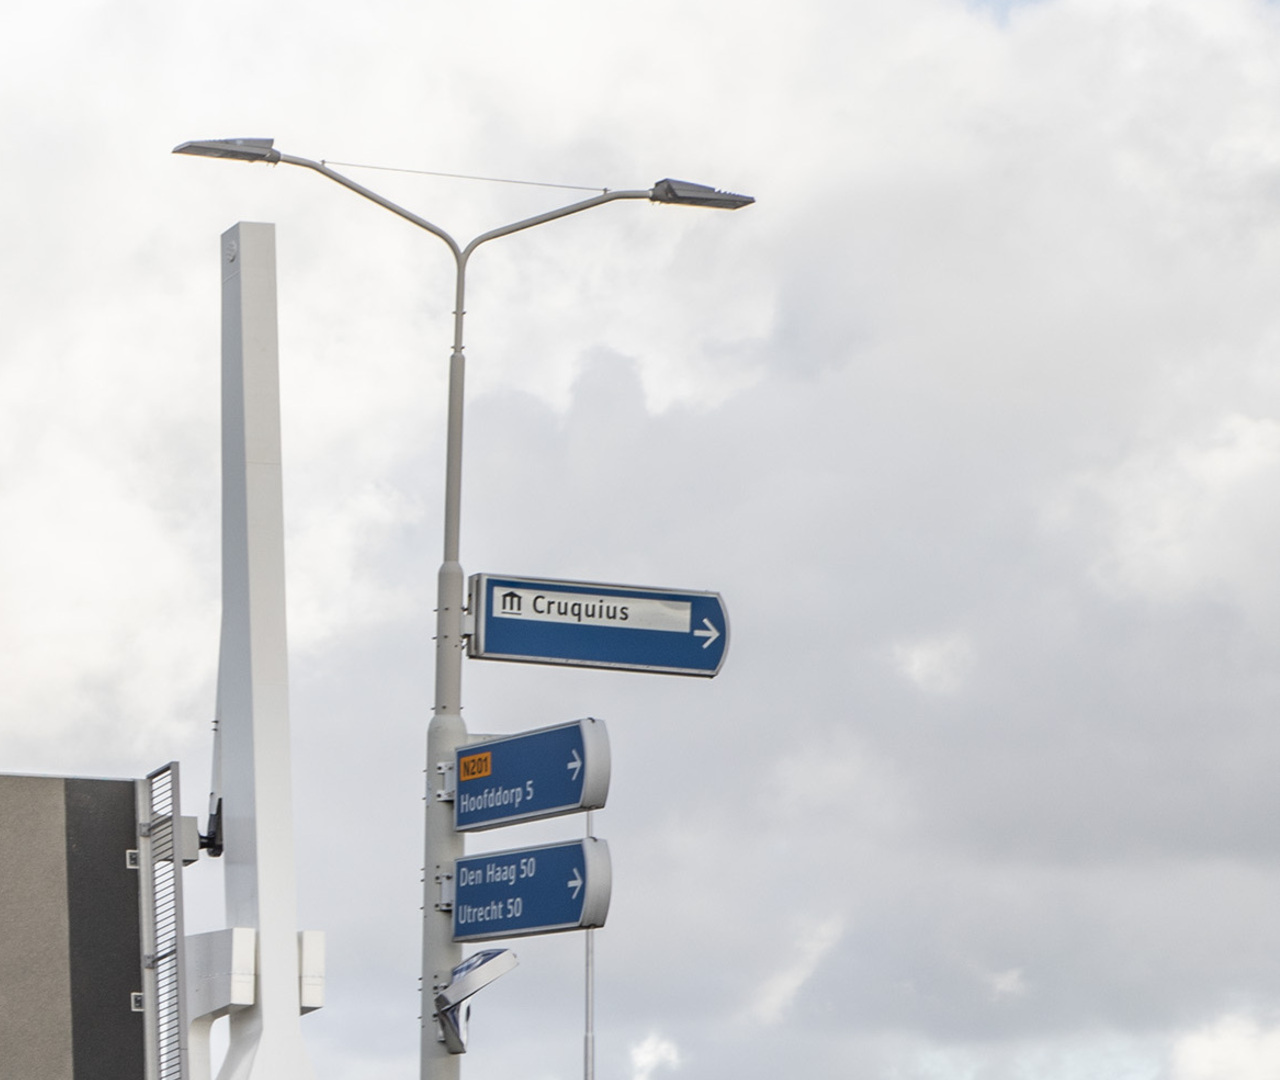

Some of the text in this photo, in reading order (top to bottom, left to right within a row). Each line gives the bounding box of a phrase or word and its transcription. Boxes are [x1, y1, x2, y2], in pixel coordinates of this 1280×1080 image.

[533, 595, 629, 622] Cruquius
[463, 756, 489, 777] N201
[460, 780, 534, 813] Hoofddorp 5
[460, 857, 536, 887] Den Haag 50
[458, 897, 523, 924] Utrecht 50
